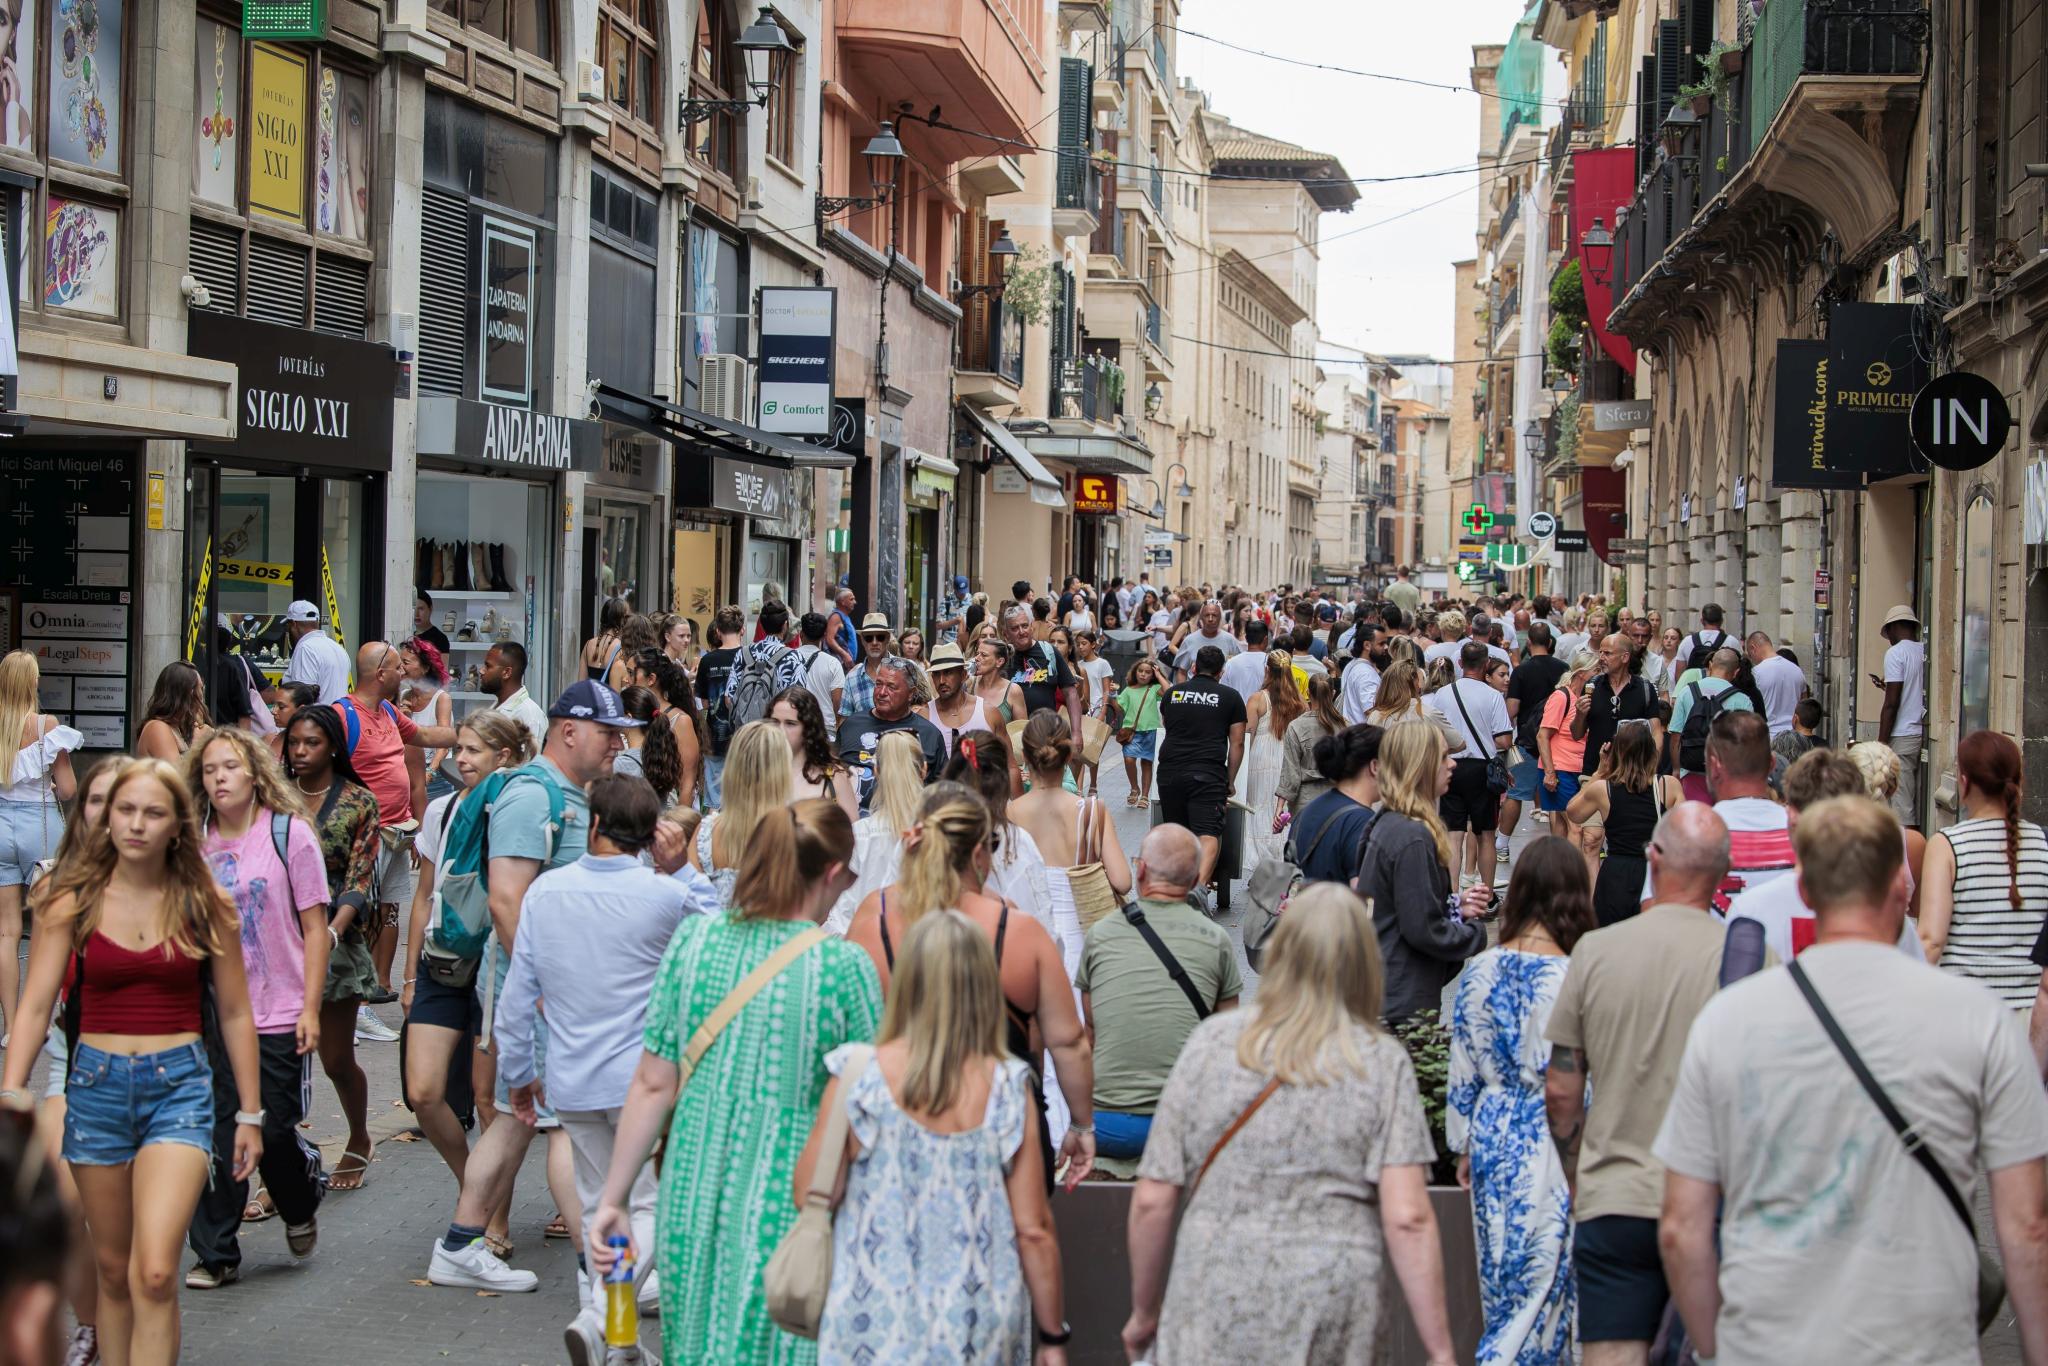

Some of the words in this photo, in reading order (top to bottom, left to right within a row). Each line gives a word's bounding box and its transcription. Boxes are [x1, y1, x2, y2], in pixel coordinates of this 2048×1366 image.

[257, 111, 297, 147] SIGLO
[264, 148, 288, 180] XXI
[488, 286, 527, 313] ZAPATERIA
[487, 320, 525, 345] ANDARINA
[278, 355, 325, 378] JOYERÍAS
[768, 356, 826, 365] SKECHERS
[246, 388, 306, 433] SIGLO
[312, 397, 350, 438] XXI
[783, 403, 825, 415] Comfort
[1808, 358, 1828, 470] primichi.com
[1933, 398, 1988, 445] IN
[483, 405, 571, 469] ANDARINA
[23, 457, 54, 471] Sant
[58, 458, 102, 475] Miquel
[107, 459, 124, 472] 46
[609, 438, 631, 475] LUSH
[245, 565, 281, 580] LOS
[43, 589, 79, 601] Escala
[82, 589, 111, 601] Dreta
[30, 611, 85, 629] Omnia
[47, 646, 112, 665] LegalSteps
[1183, 691, 1219, 704] FNG
